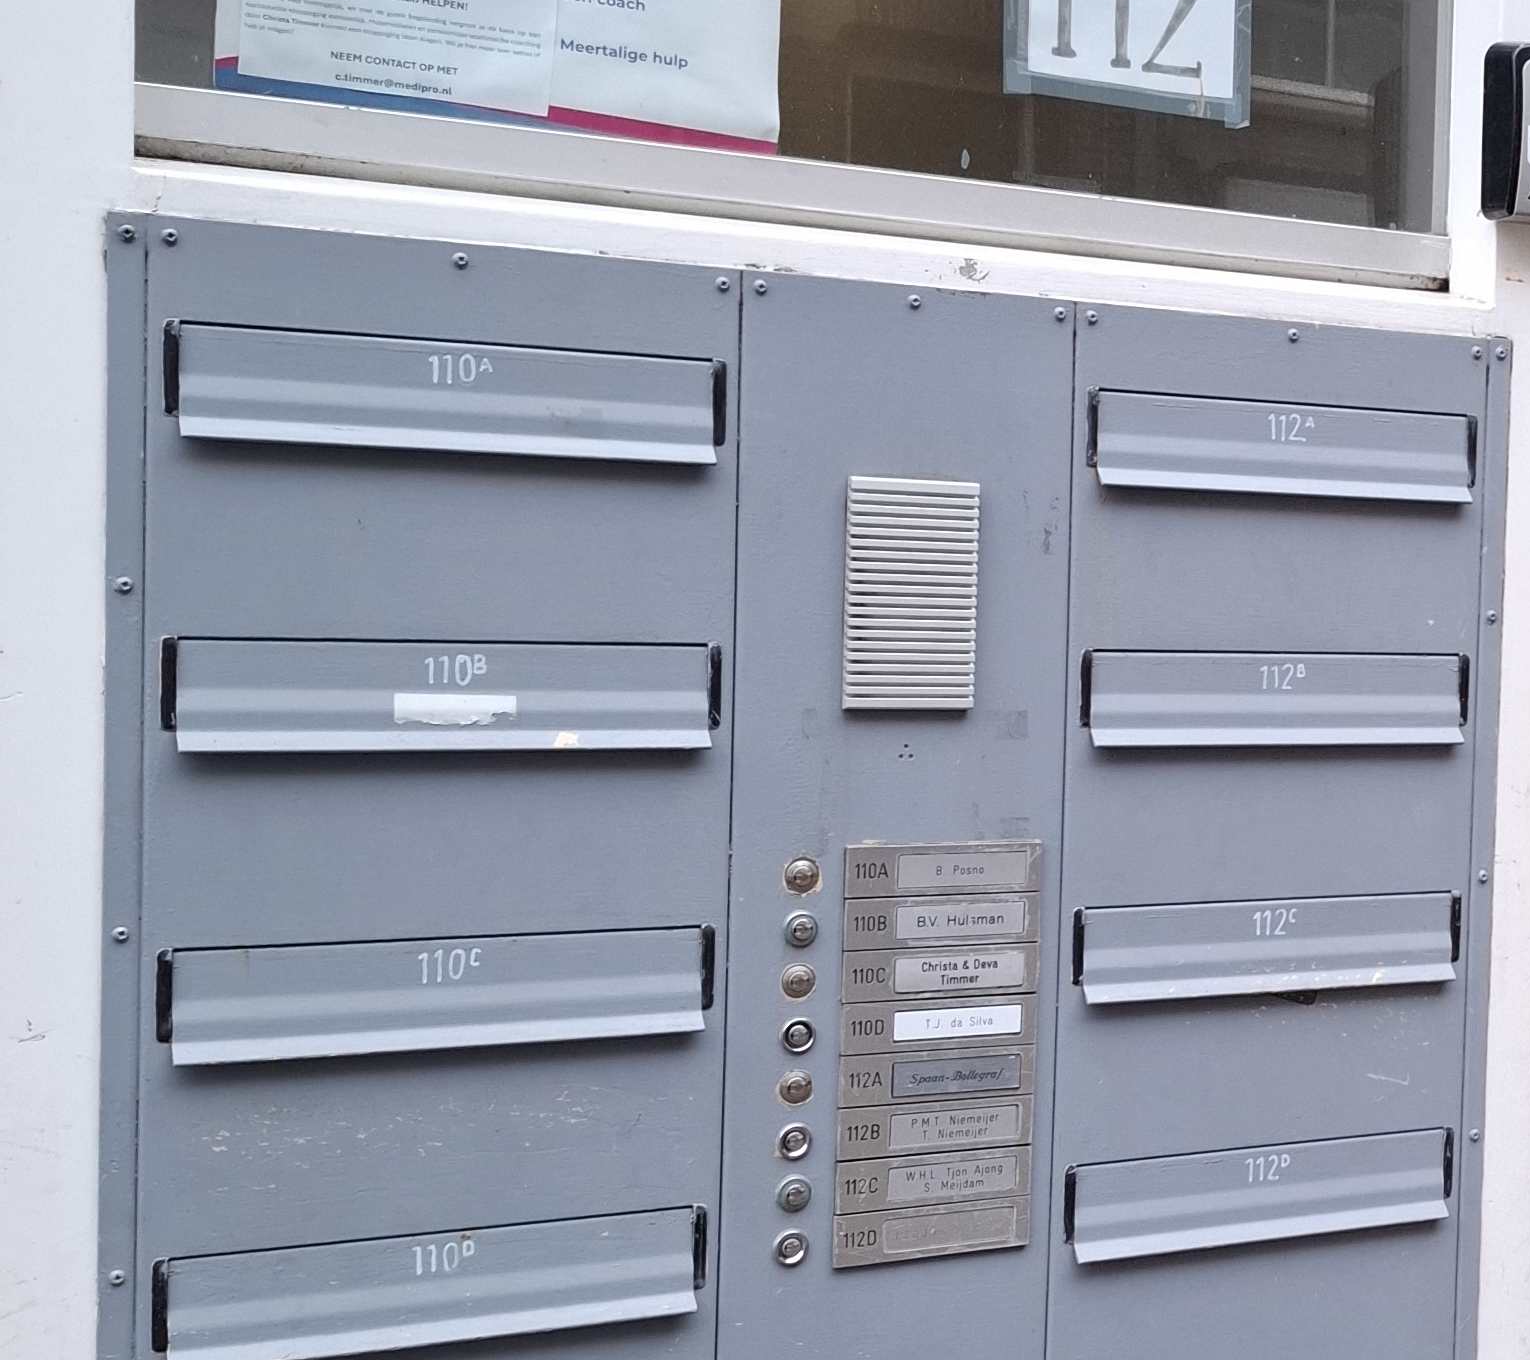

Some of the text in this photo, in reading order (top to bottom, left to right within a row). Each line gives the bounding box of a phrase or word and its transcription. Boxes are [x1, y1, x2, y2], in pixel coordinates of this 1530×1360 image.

[560, 38, 688, 69] Meertalige hulp
[330, 51, 458, 75] NEEM CONTACT OP MET
[428, 353, 493, 384] 110A
[1268, 413, 1315, 442] 112A
[424, 654, 488, 686] 110B
[1260, 663, 1306, 690] 112B
[855, 862, 888, 879] 110A
[953, 864, 985, 875] Posno
[854, 915, 887, 931] 110B
[1252, 908, 1298, 936] 112C
[418, 947, 482, 984] 110C
[921, 959, 998, 973] Christa & Deva
[852, 968, 886, 984] 110C
[941, 974, 980, 985] Timmer
[851, 1019, 884, 1036] 110D
[950, 1017, 962, 1028] da
[969, 1016, 993, 1027] Silva
[849, 1072, 882, 1089] 112A
[949, 1114, 999, 1126] Niemeijer
[847, 1124, 880, 1141] 112B
[938, 1127, 988, 1139] Niemeijer
[1245, 1153, 1290, 1182] 112D
[844, 1178, 878, 1195] 112C
[843, 1230, 877, 1247] 112D
[412, 1240, 475, 1276] 110D
